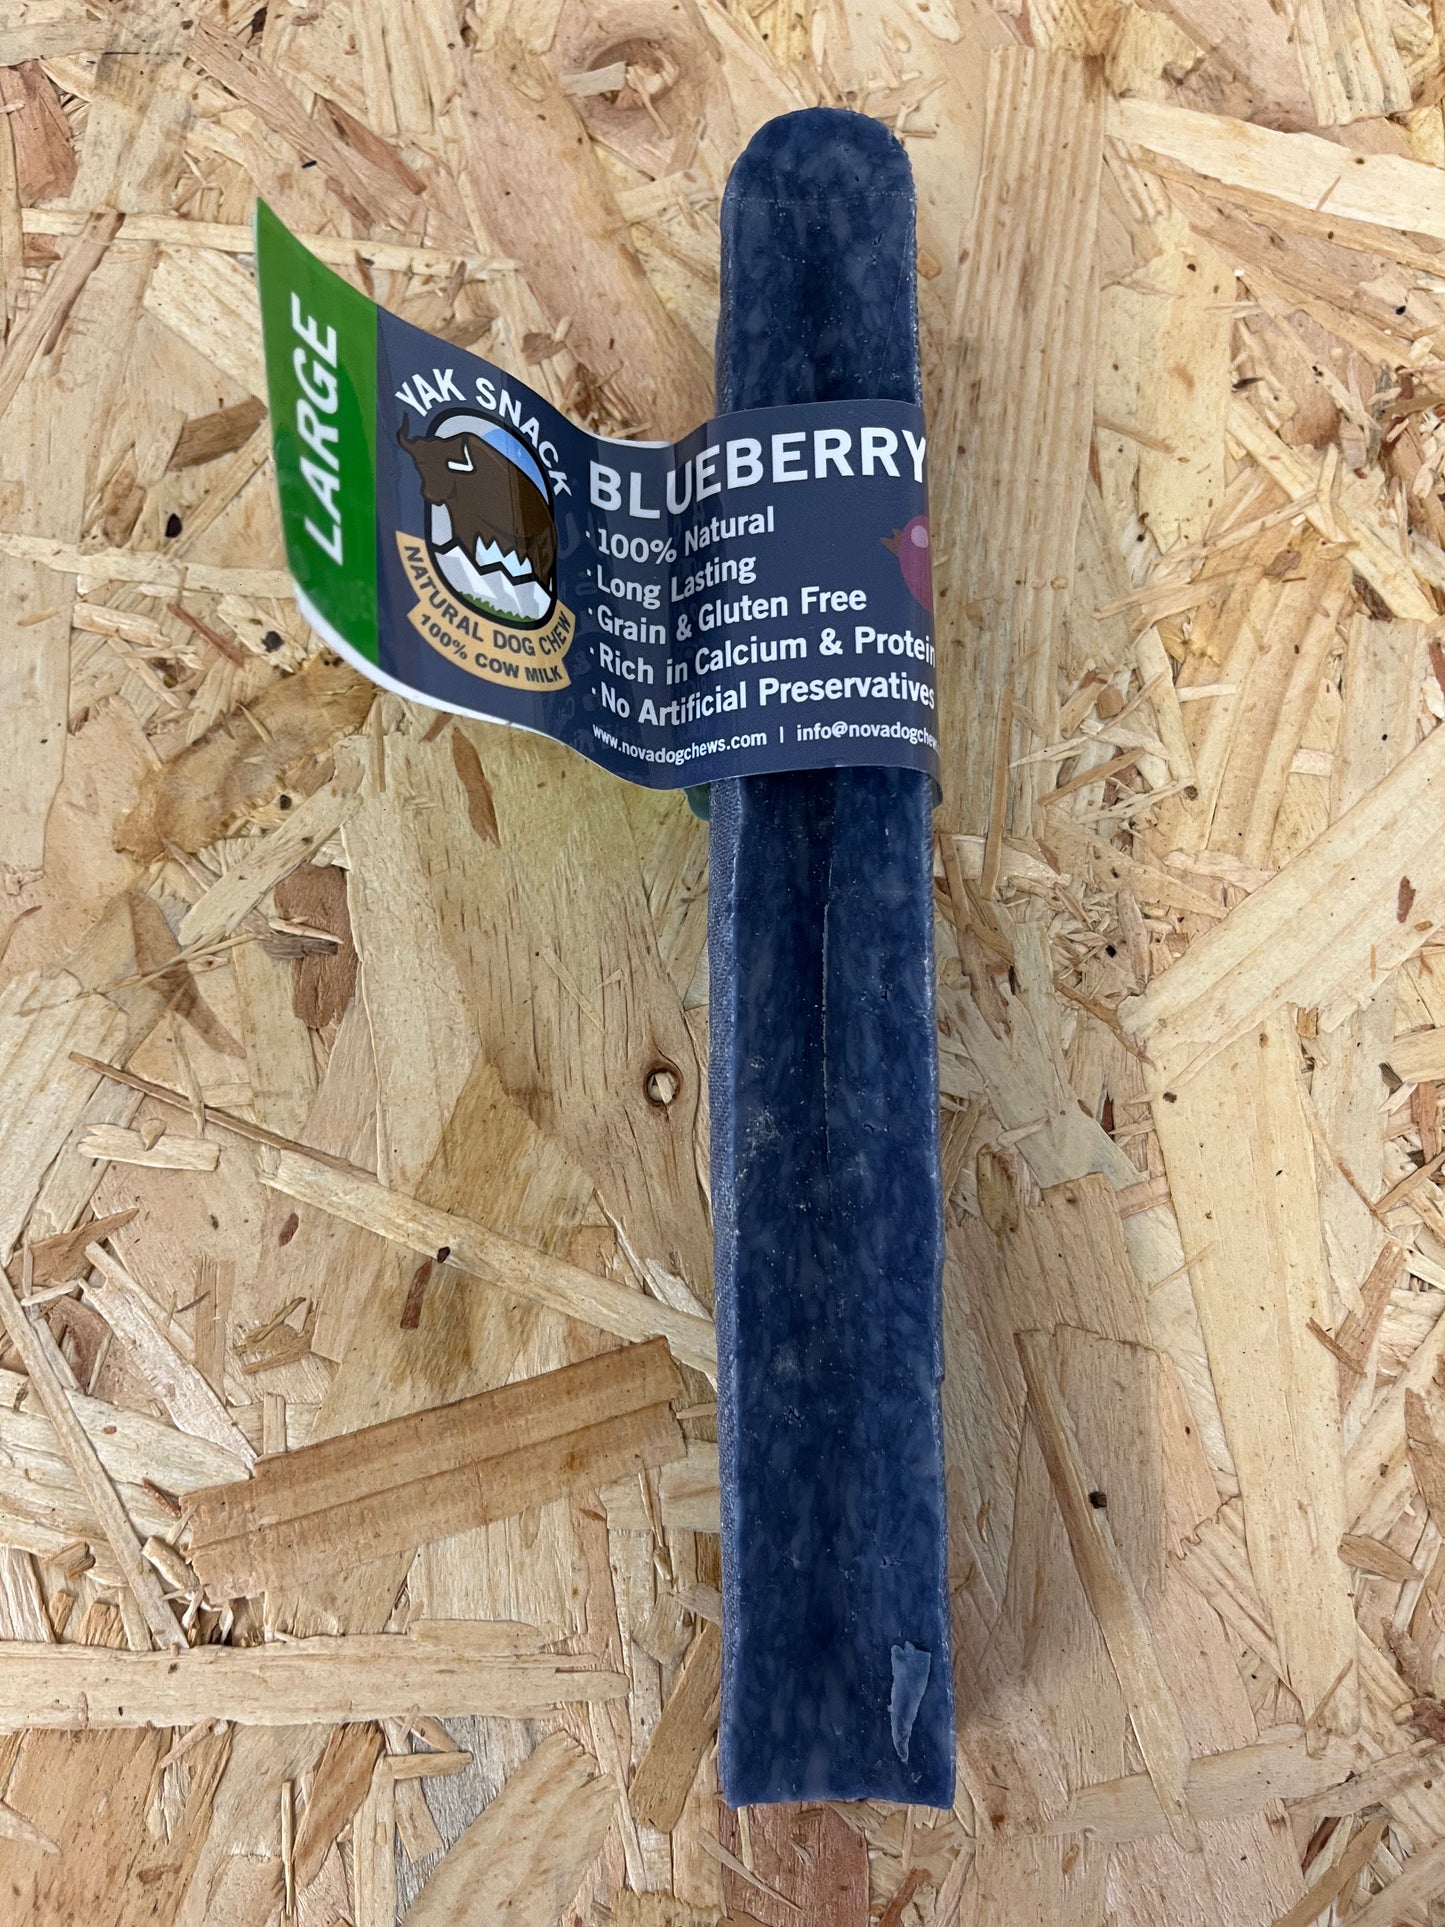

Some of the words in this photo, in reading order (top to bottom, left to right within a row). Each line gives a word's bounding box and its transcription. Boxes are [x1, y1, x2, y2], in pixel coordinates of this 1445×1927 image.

[290, 291, 344, 567] LARGE
[394, 368, 467, 417] YAK
[475, 377, 572, 496] SNACK
[589, 426, 927, 520] BLUEBERRY
[684, 505, 775, 557] Natural
[403, 545, 485, 643] NATURAL
[492, 629, 536, 657] DOG
[538, 610, 571, 656] CHEW
[670, 556, 758, 603] Lasting
[675, 613, 693, 642] &
[697, 594, 788, 632] Gluten
[800, 585, 867, 615] Free
[421, 612, 468, 660] 100%
[474, 652, 520, 679] COW
[524, 664, 563, 684] MILK
[665, 658, 689, 686] in
[694, 635, 808, 675] Calcium
[818, 627, 844, 657] &
[854, 625, 937, 669] Protein
[637, 681, 747, 727] Artificial
[758, 671, 935, 710] Preservatives
[592, 723, 768, 766] www.novadogchews.com
